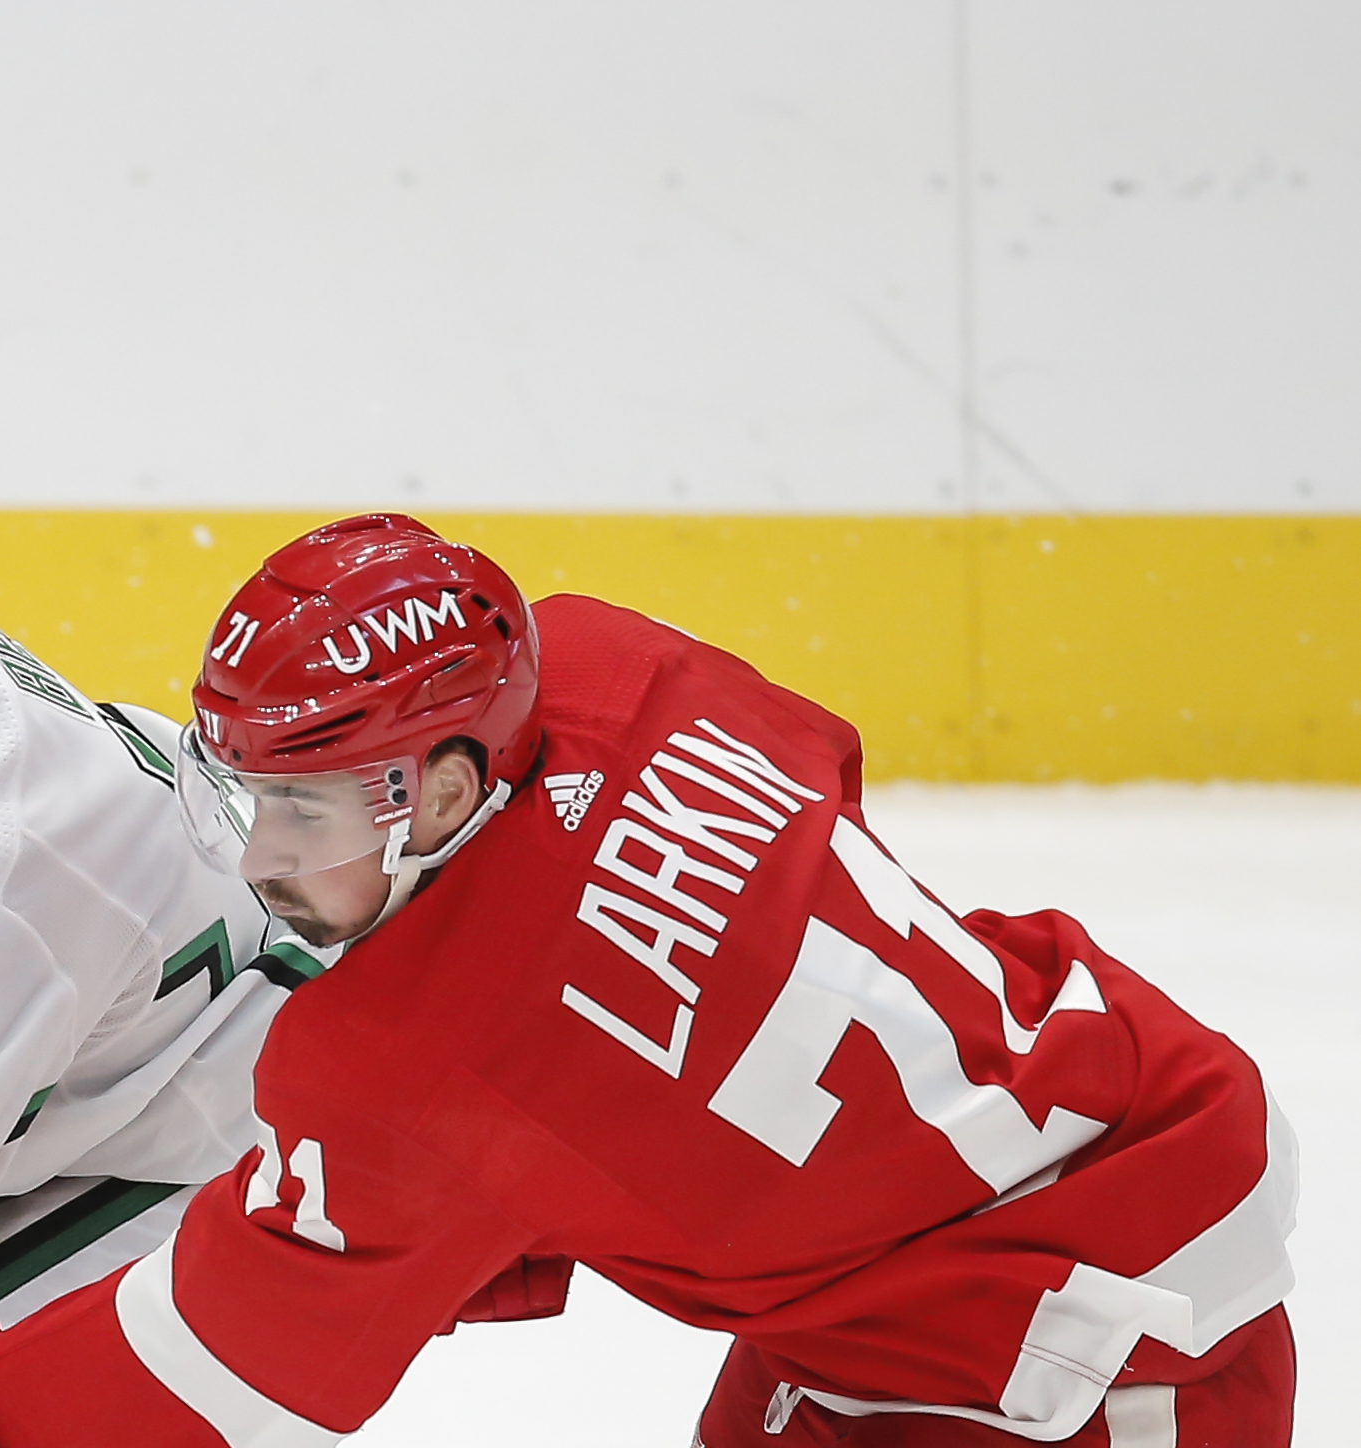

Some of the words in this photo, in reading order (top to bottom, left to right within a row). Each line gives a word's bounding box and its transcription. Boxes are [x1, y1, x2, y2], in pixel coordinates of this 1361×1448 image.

[210, 611, 261, 669] 71
[322, 589, 468, 675] UWM
[562, 769, 606, 832] adidas
[561, 717, 826, 1080] LARKIN
[706, 813, 1109, 1197] 71
